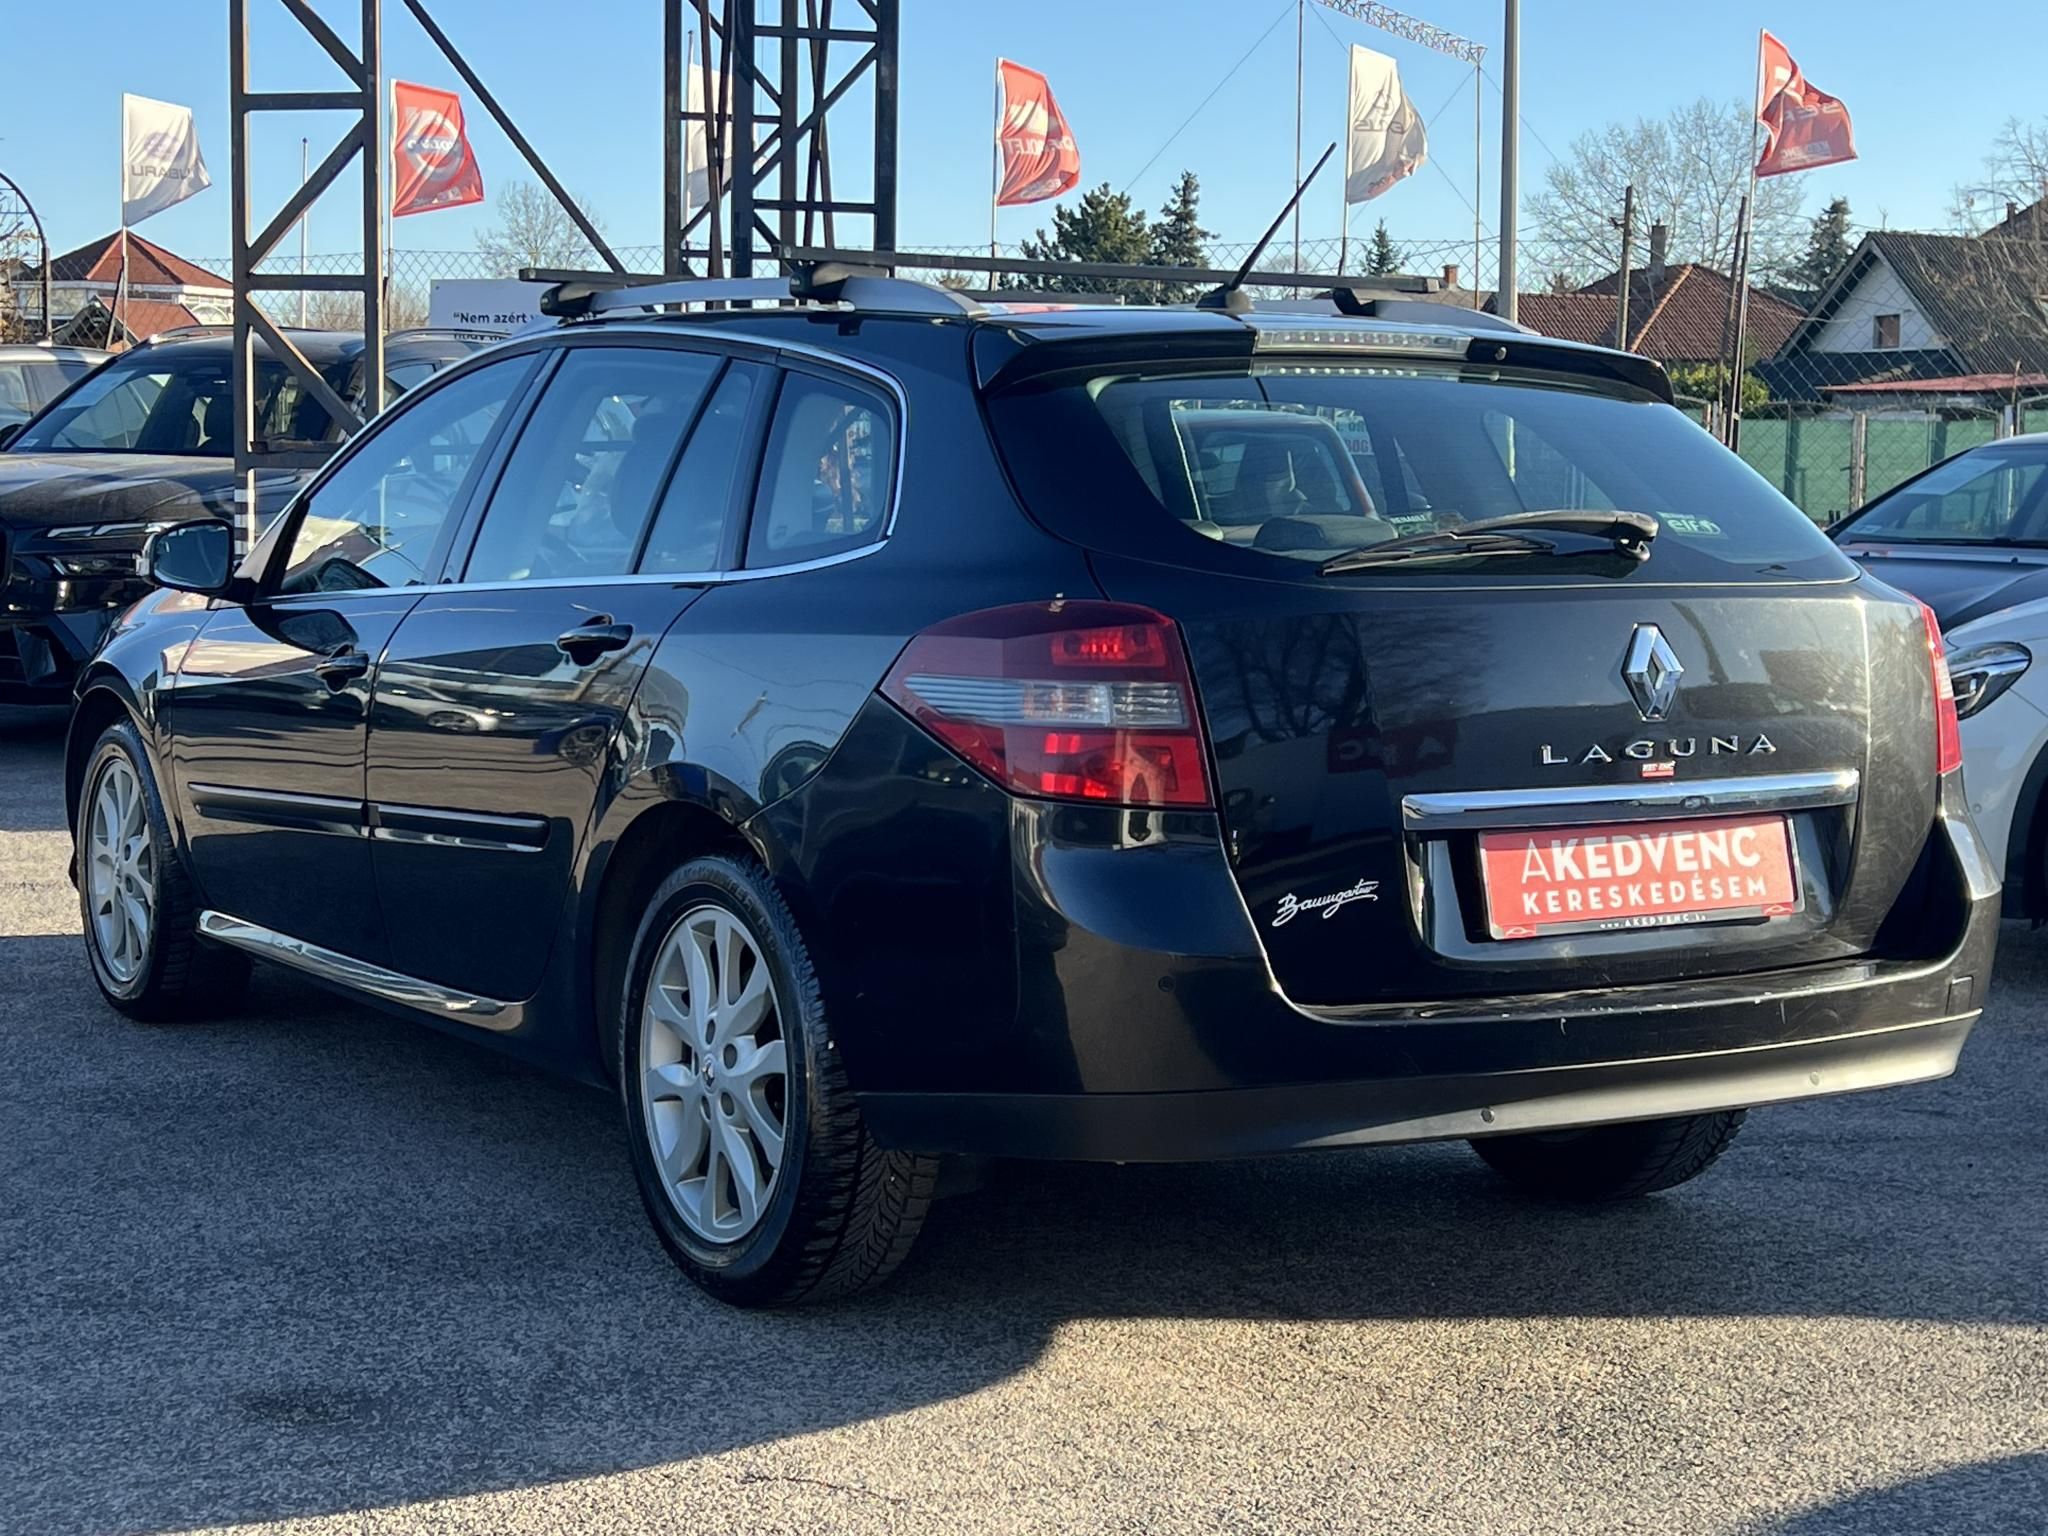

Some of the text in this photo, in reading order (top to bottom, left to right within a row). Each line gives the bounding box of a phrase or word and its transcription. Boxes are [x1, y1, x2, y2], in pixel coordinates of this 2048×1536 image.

[494, 311, 527, 323] azért
[1541, 733, 1777, 765] LAGUNA
[1521, 827, 1761, 884] AKEDVENC
[1523, 873, 1768, 915] KERESKEDÉSEM
